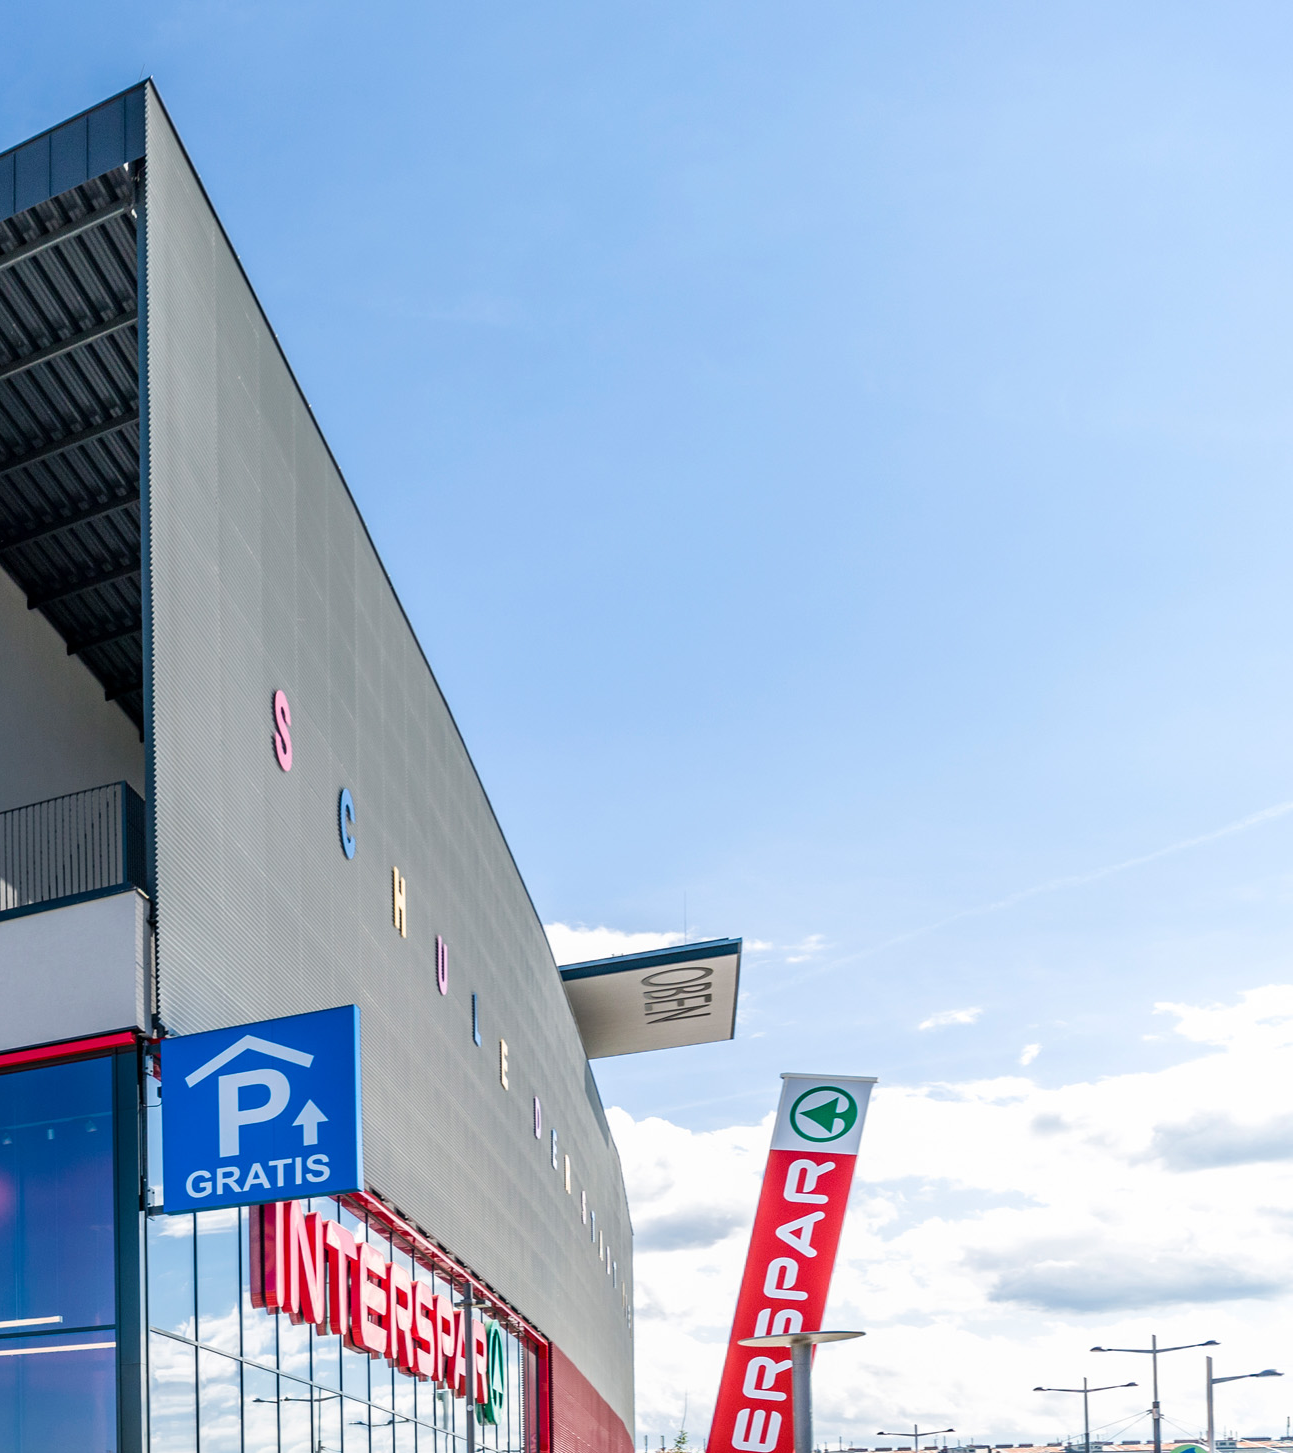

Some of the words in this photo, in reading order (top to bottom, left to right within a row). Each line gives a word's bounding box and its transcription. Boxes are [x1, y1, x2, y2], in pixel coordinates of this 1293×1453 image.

[273, 689, 509, 1091] SCHULE
[641, 966, 714, 1024] OBEN
[218, 1068, 291, 1158] P
[185, 1154, 331, 1198] GRATIS
[265, 1199, 489, 1404] INTERSPAR
